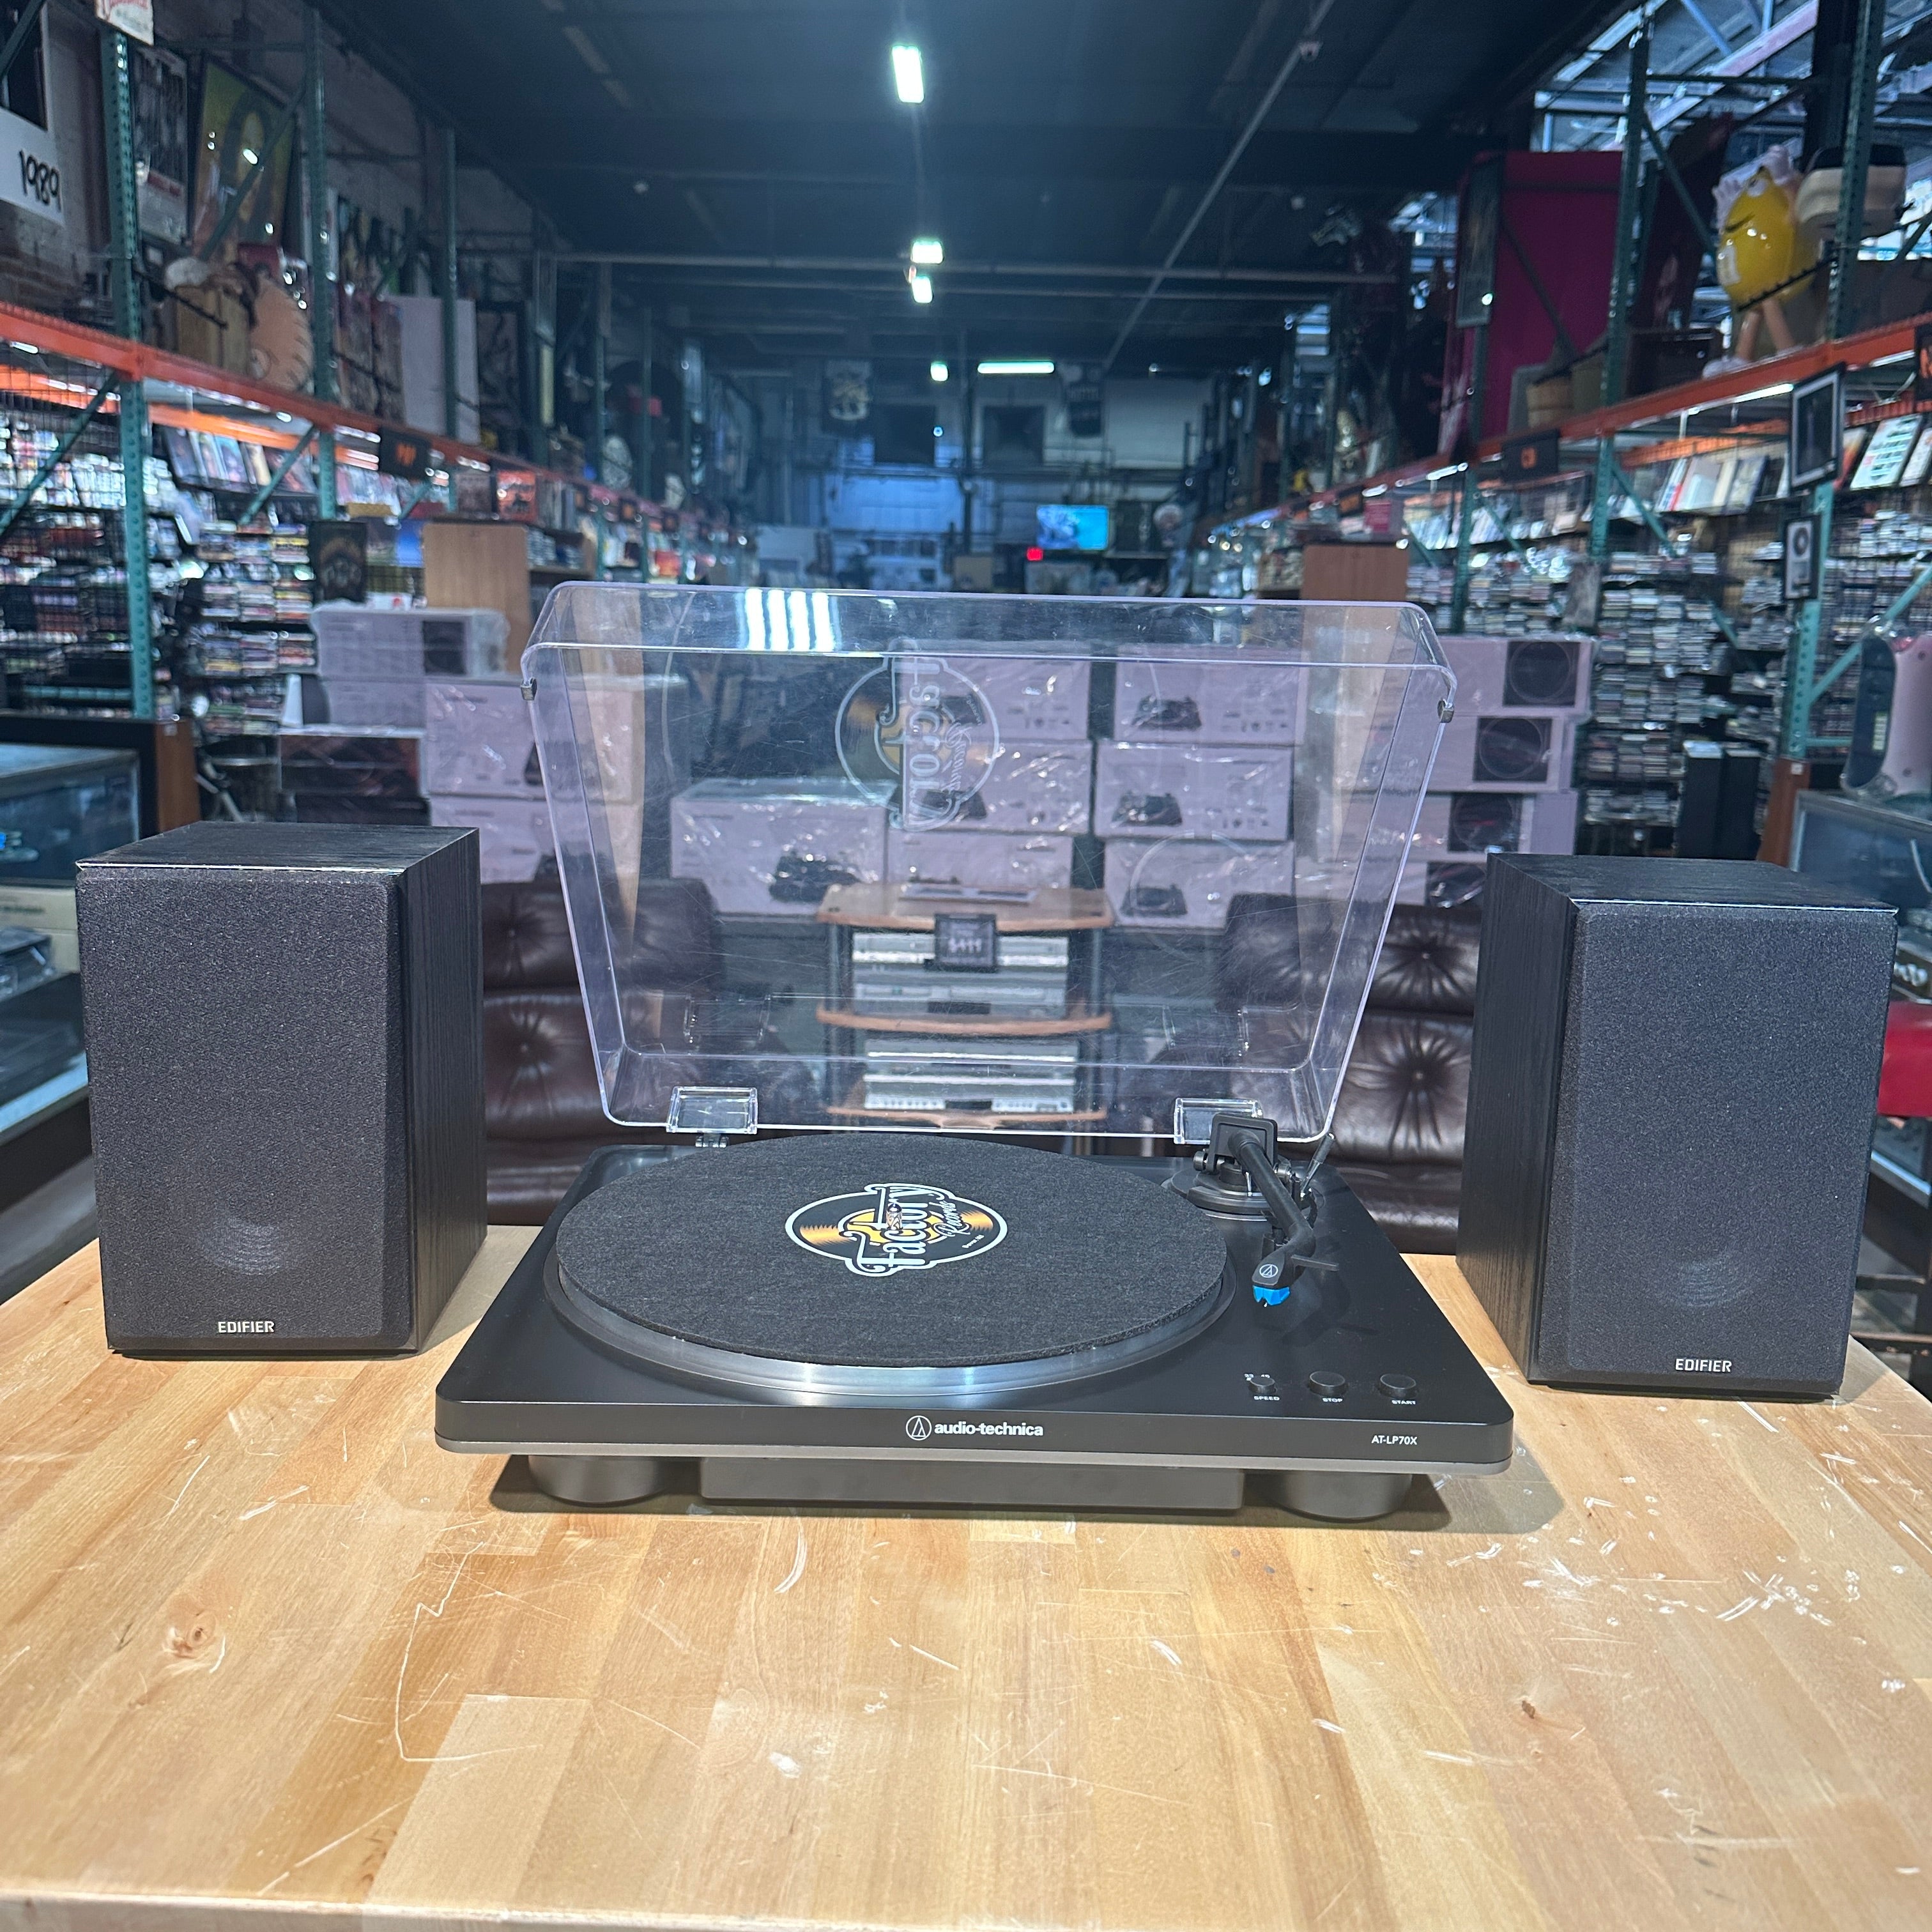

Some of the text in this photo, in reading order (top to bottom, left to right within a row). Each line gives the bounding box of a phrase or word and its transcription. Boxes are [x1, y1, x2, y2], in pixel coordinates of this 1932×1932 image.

[19, 150, 61, 211] 1989
[930, 1200, 970, 1237] Records
[838, 1184, 946, 1273] Factory
[218, 1321, 275, 1333] EDIFIER
[1675, 1358, 1732, 1372] EDIFIER
[934, 1421, 1044, 1436] audio-technica
[1371, 1434, 1418, 1446] AT-LP70X
